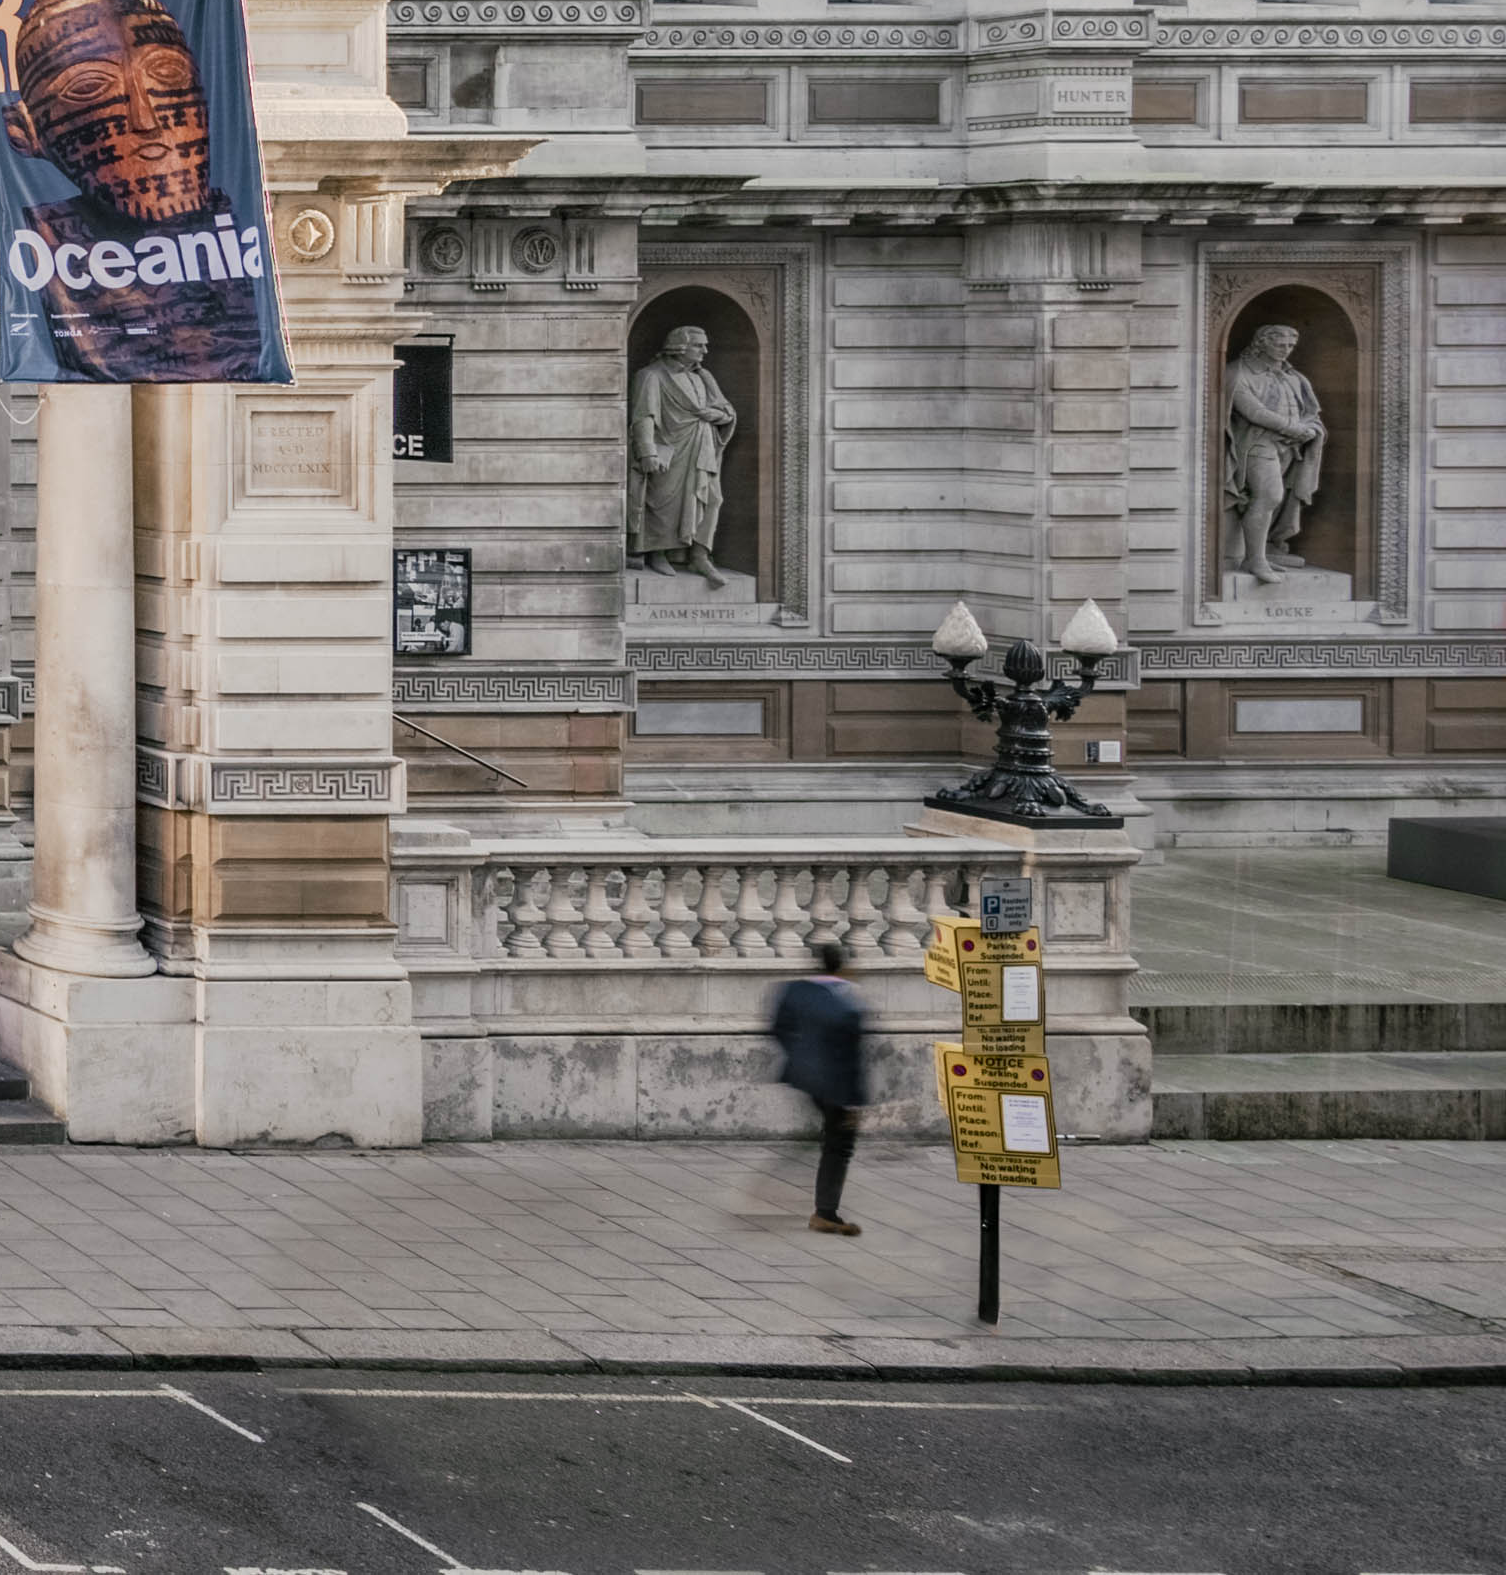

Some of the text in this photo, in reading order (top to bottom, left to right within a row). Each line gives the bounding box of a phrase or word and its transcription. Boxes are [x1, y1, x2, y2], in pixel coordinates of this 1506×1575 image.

[8, 213, 264, 292] Oceania
[258, 426, 324, 438] ERECTED
[650, 609, 736, 619] ADAM SMITH
[1265, 607, 1314, 618] LOCKE
[986, 942, 1018, 951] Parking
[980, 952, 1025, 961] Suspended
[981, 1034, 1026, 1043] No waiting
[995, 1044, 1026, 1053] loading
[973, 1056, 1025, 1068] NOTICE
[981, 1069, 1019, 1080] Parking
[973, 1078, 1028, 1089] Suspended
[956, 1091, 986, 1101] From:
[957, 1104, 986, 1113] Until:
[960, 1127, 1002, 1138] Reason:
[980, 1162, 1037, 1175] No waiting
[981, 1172, 1038, 1186] No loading
